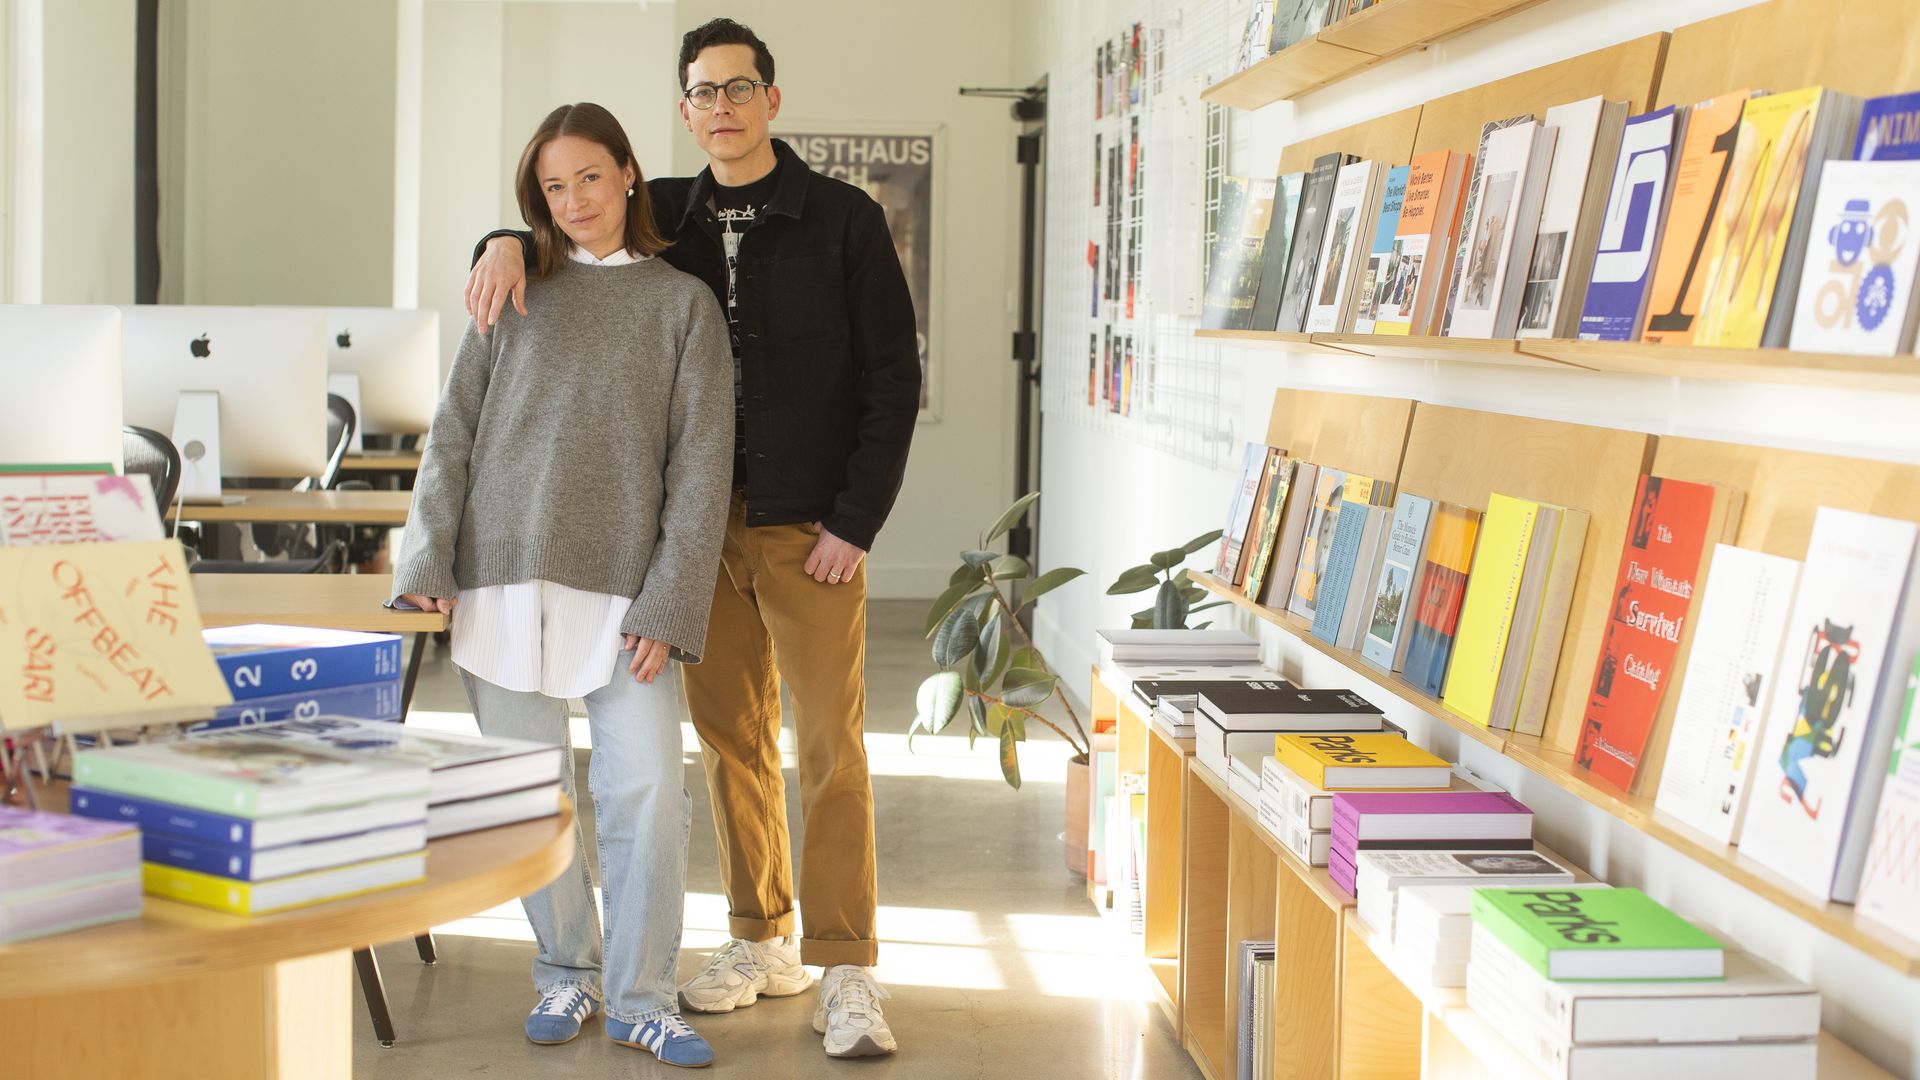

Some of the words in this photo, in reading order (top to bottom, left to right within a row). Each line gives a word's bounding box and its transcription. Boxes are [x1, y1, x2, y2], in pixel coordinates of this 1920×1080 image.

[784, 137, 930, 165] NSTHAUS
[1657, 524, 1673, 544] The
[1626, 560, 1649, 585] New
[145, 554, 180, 637] THE
[52, 559, 175, 701] OFFBEAT
[1626, 599, 1684, 644] Survival
[235, 664, 263, 688] 2
[291, 657, 318, 681] 3
[1623, 652, 1663, 691] Catalog
[1299, 735, 1377, 763] Parks
[1506, 891, 1621, 944] Parks
